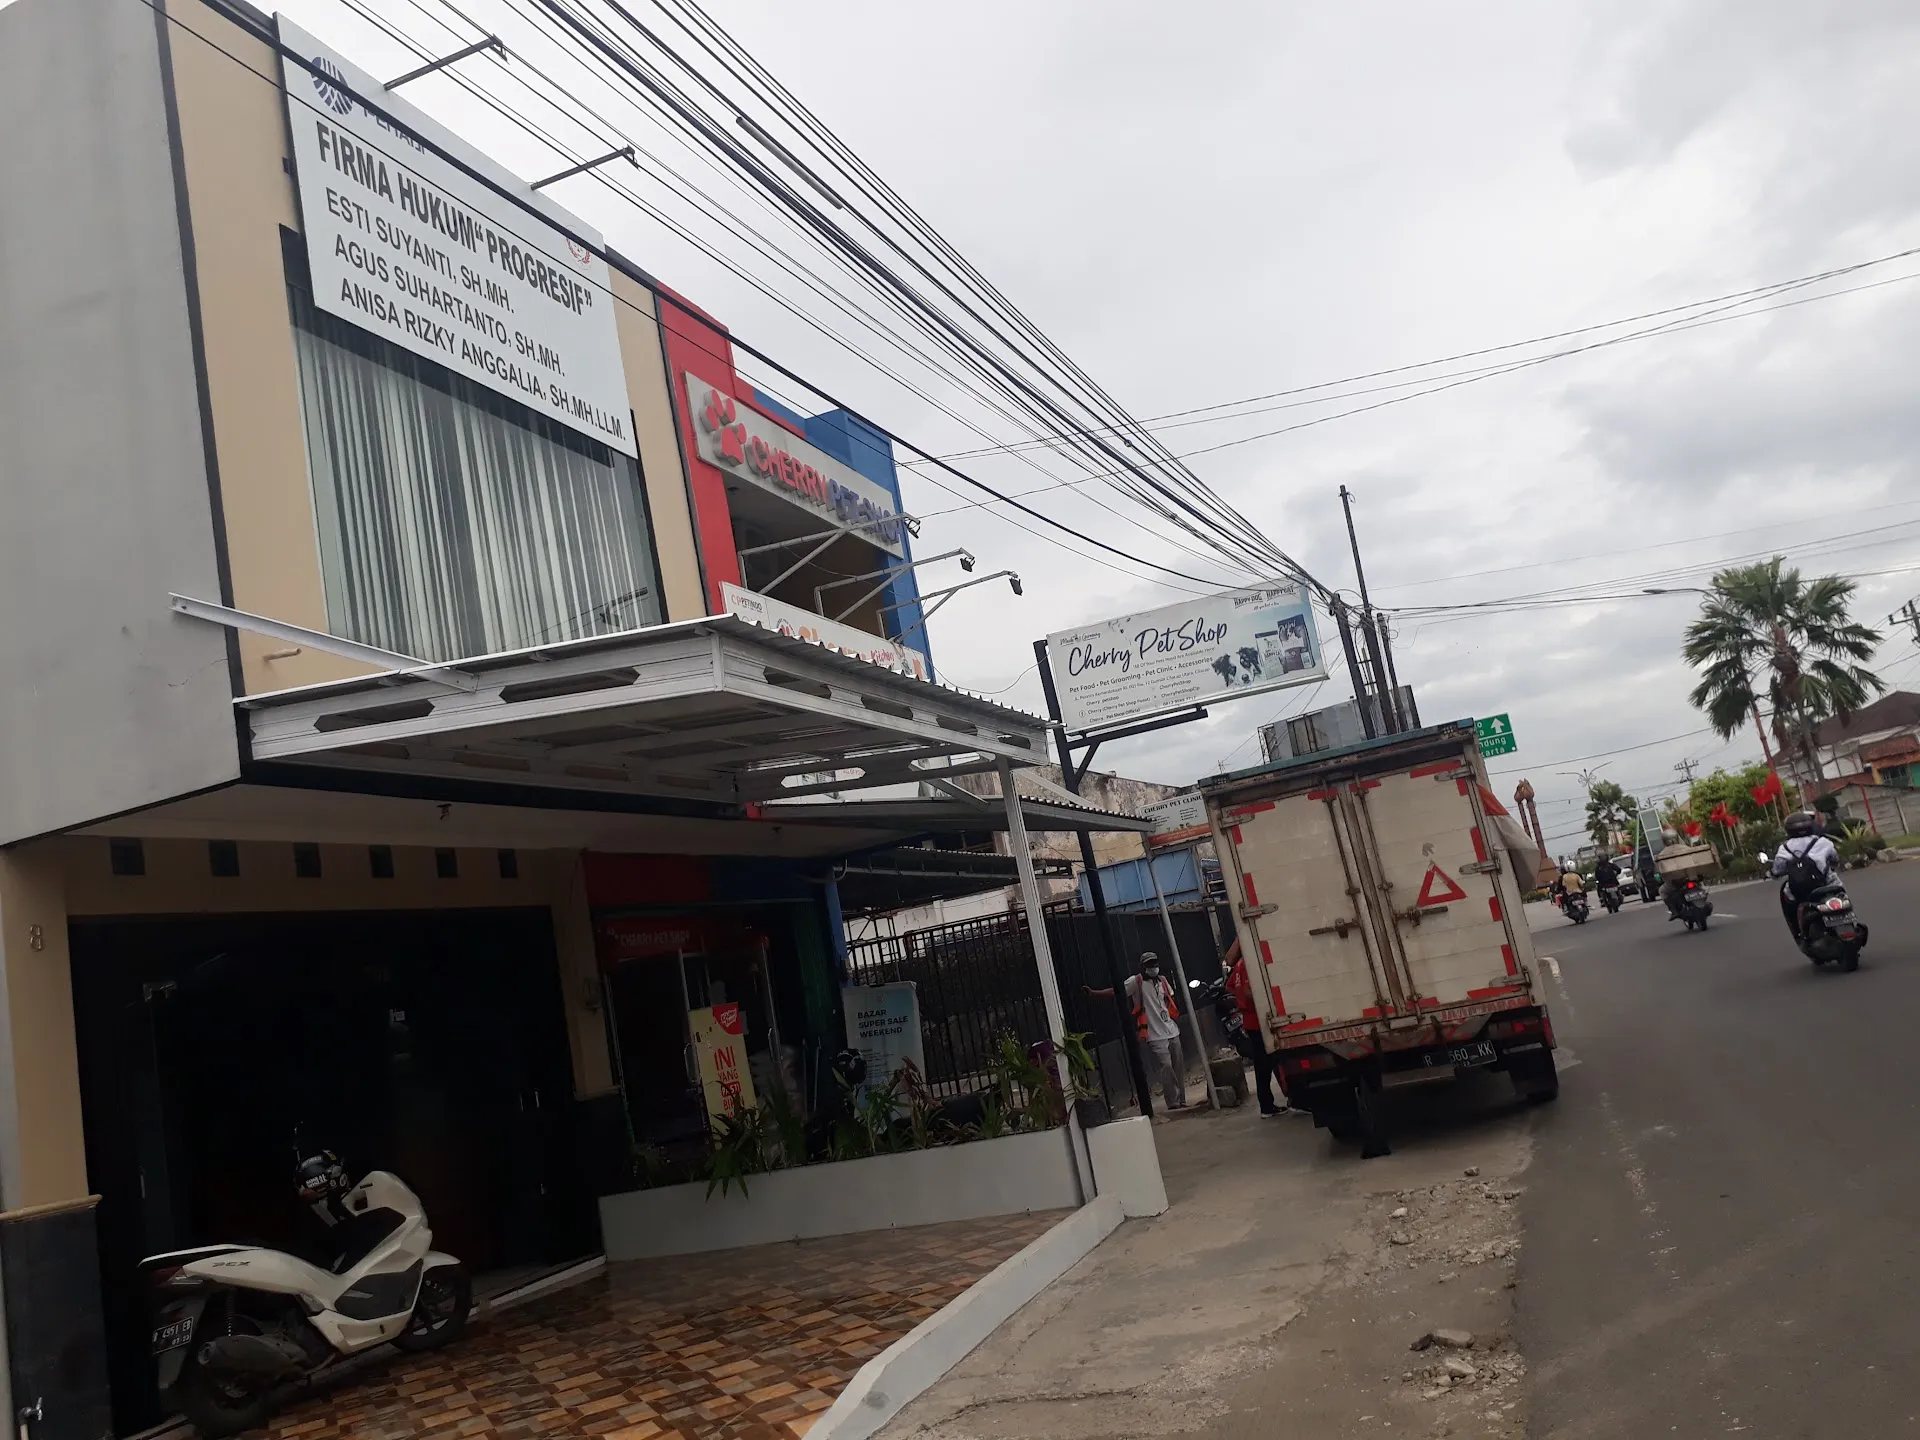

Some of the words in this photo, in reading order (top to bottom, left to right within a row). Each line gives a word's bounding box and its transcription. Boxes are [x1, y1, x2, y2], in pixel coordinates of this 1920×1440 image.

[316, 120, 395, 204] FIRMA
[325, 186, 371, 234] ESTI
[375, 216, 457, 284] SUYANTI,
[460, 264, 515, 314] SH.MH.
[335, 233, 389, 283] AGUS
[394, 265, 512, 347] SUHARTANTO,
[514, 330, 566, 377] SH.MH.
[341, 277, 402, 329] ANISA
[403, 307, 455, 355] RIZKY
[461, 338, 547, 401] ANGGALIA,
[750, 435, 829, 506] CHERRY
[1069, 643, 1132, 676] Cherry
[1080, 682, 1096, 691] Food
[1099, 679, 1110, 687] Pet
[1110, 673, 1141, 685] Grooming
[1145, 669, 1156, 677] Pet
[1156, 665, 1173, 674] Clinic
[1178, 656, 1213, 669] Accessories
[1144, 803, 1168, 814] CHERRY
[1170, 799, 1181, 808] PET
[857, 1009, 887, 1019] BAZAR
[859, 1019, 886, 1029] SUPER
[887, 1015, 909, 1025] SALE
[860, 1026, 903, 1038] WEEKEND
[713, 1046, 736, 1071] INI
[1424, 1055, 1433, 1067] R
[1477, 1041, 1493, 1057] KK
[718, 1069, 739, 1082] YANG
